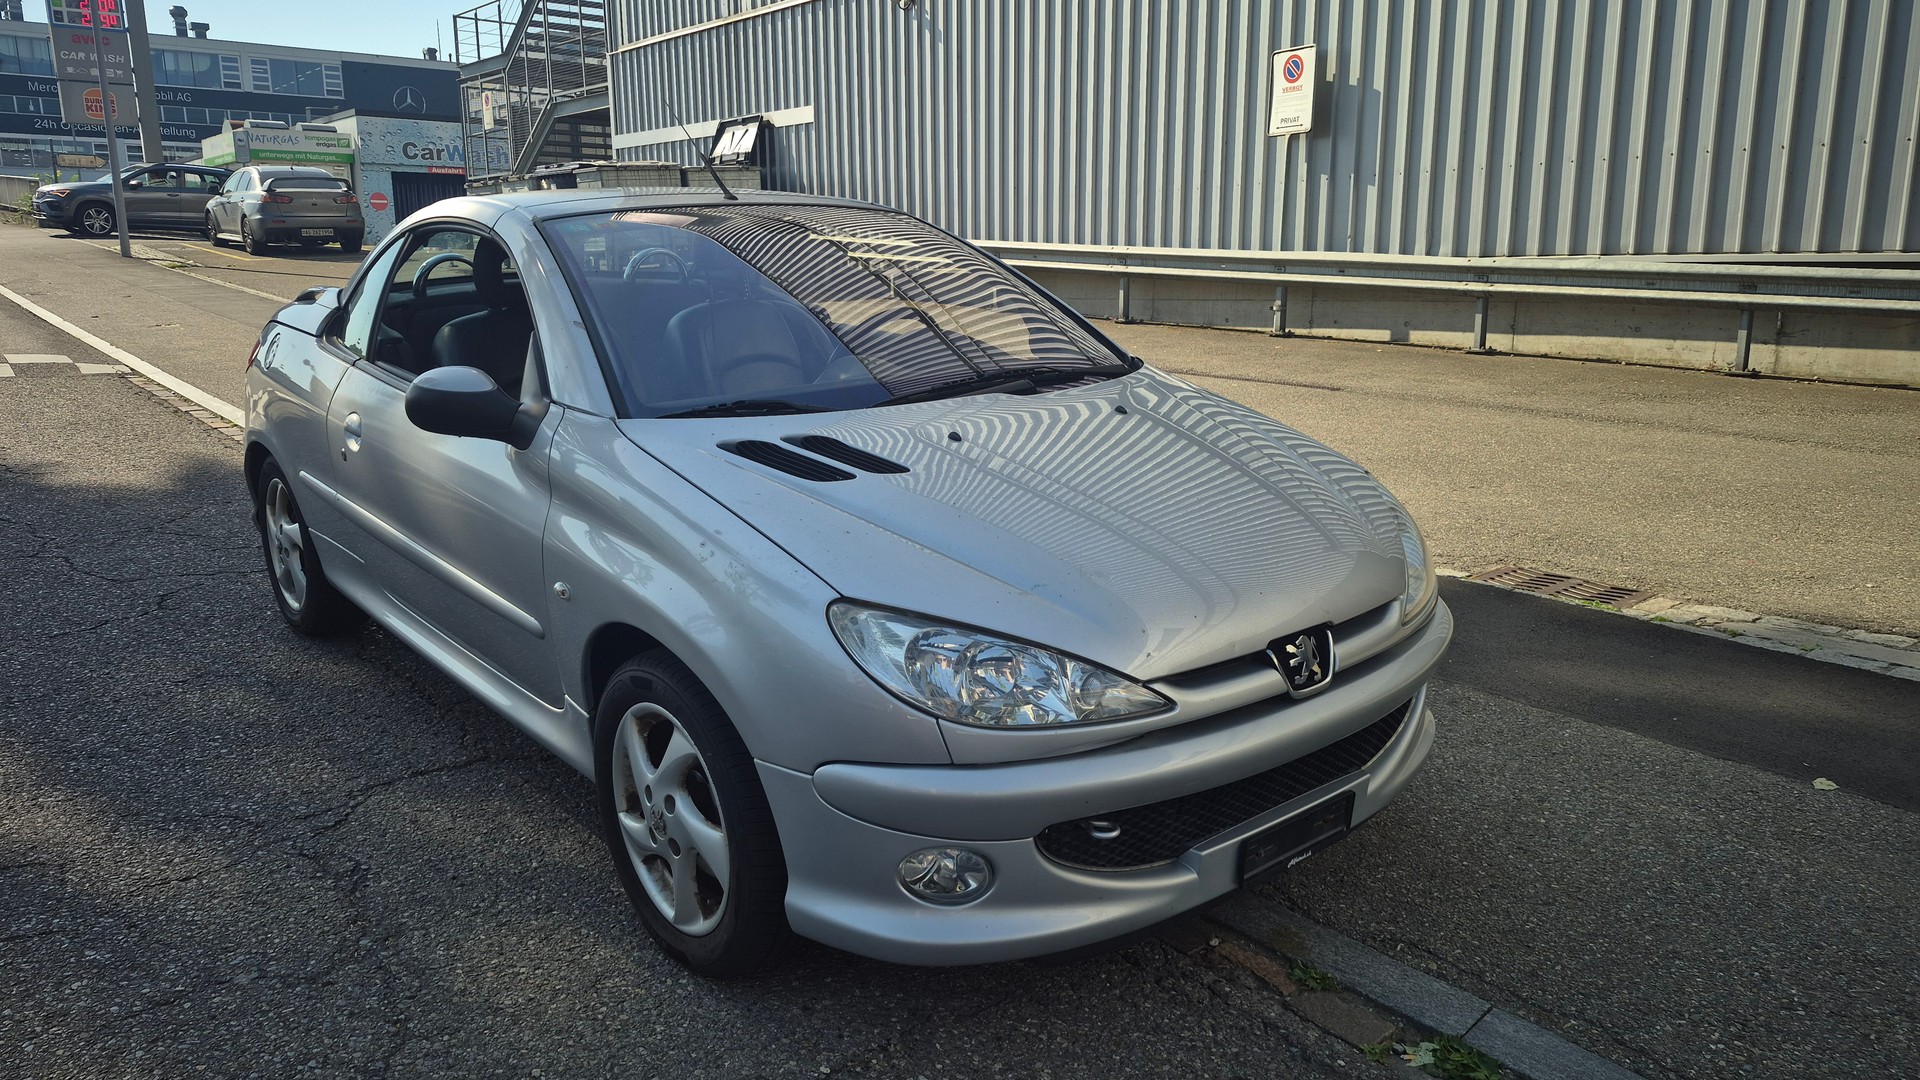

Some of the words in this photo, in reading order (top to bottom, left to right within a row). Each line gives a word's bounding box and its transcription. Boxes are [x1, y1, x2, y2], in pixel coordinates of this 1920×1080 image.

[60, 50, 86, 61] CAR
[176, 92, 192, 103] AG
[34, 118, 57, 129] 24h
[1280, 116, 1300, 124] PRIVAT
[304, 134, 337, 143] kompogas
[258, 151, 294, 160] unterwegs
[431, 166, 463, 175] Ausfahrt
